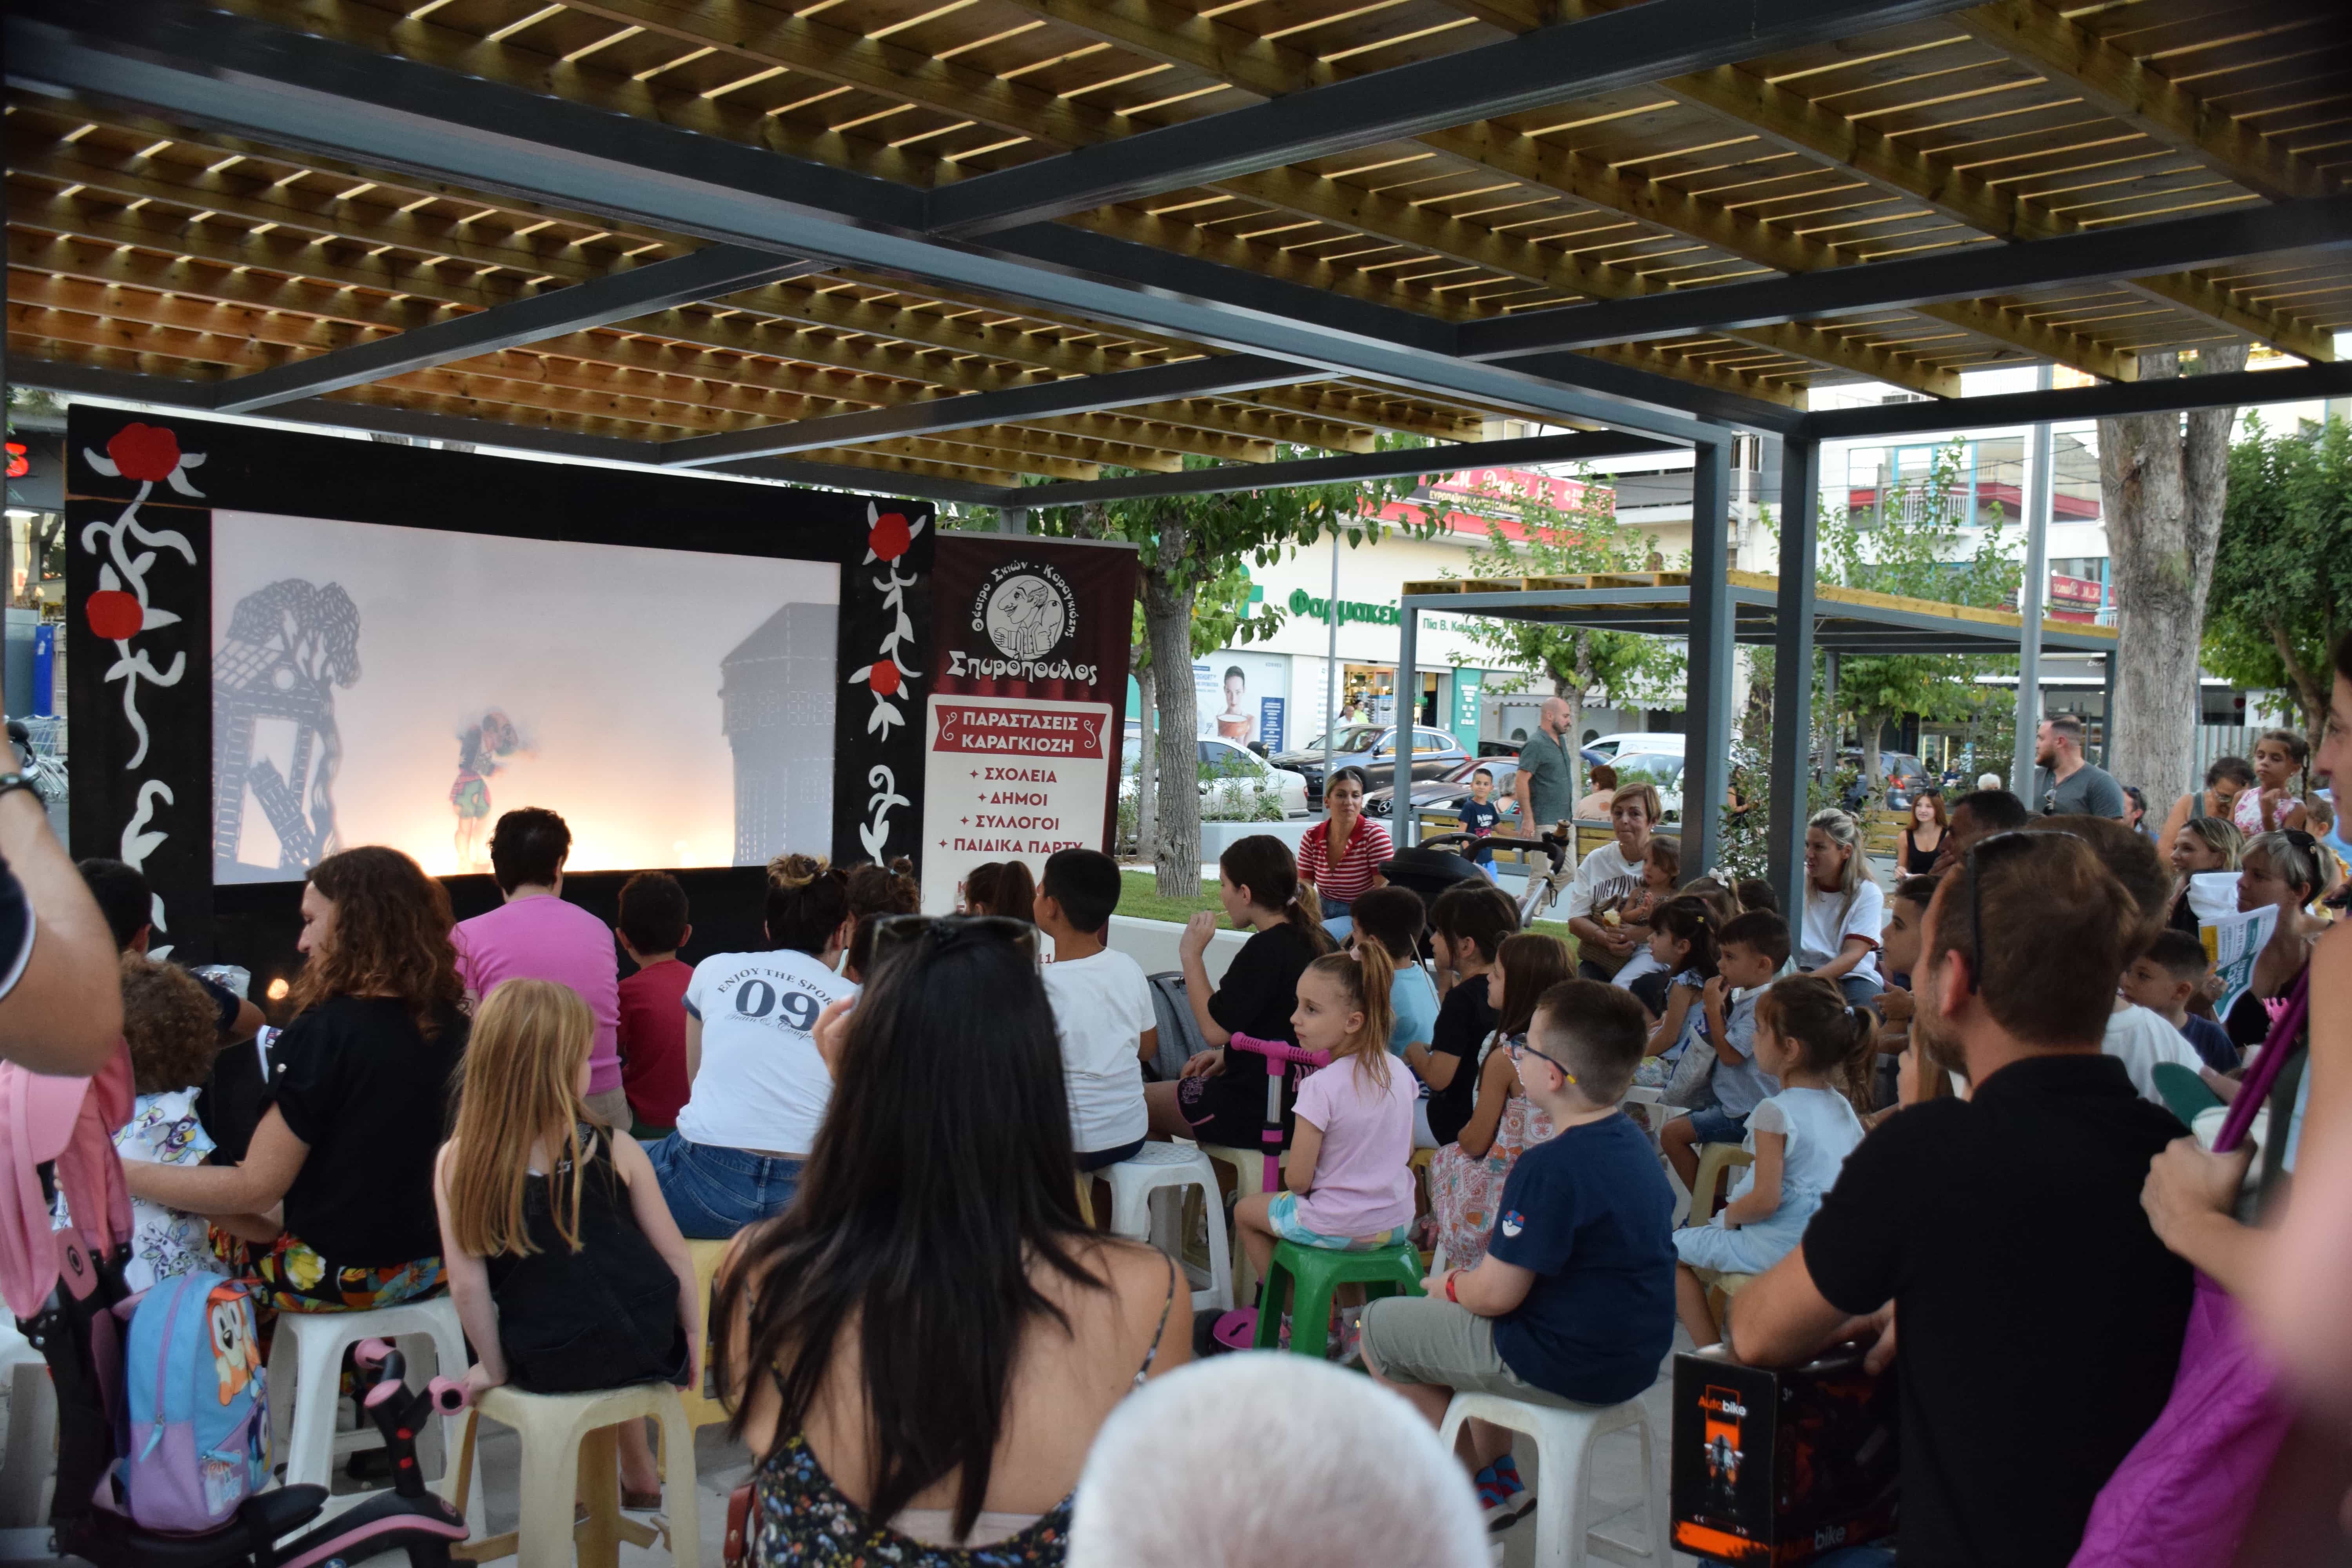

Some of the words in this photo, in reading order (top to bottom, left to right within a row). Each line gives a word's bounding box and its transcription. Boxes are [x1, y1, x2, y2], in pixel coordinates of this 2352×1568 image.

[971, 583, 991, 632] Θέατρο
[991, 560, 1029, 583] Σκιών
[1043, 564, 1079, 638] Καραγκιόζης
[963, 711, 1078, 731] ΠΑΡΑΣΤΑΣΕΙΣ
[962, 734, 1074, 753] ΚΑΡΑΓΚΙΟΖΗ
[984, 767, 1057, 783] ΣΧΟΛΕΙΑ
[990, 791, 1047, 806] ΔΗΜΟΙ
[975, 815, 1059, 831] ΣΥΛΛΟΓΟΙ
[954, 838, 1023, 853] ΠΑΙΔΙΚΑ
[717, 967, 760, 994] ENJOY
[764, 969, 795, 982] THE
[736, 979, 820, 1032] 09
[1697, 1395, 1747, 1417] Autobike
